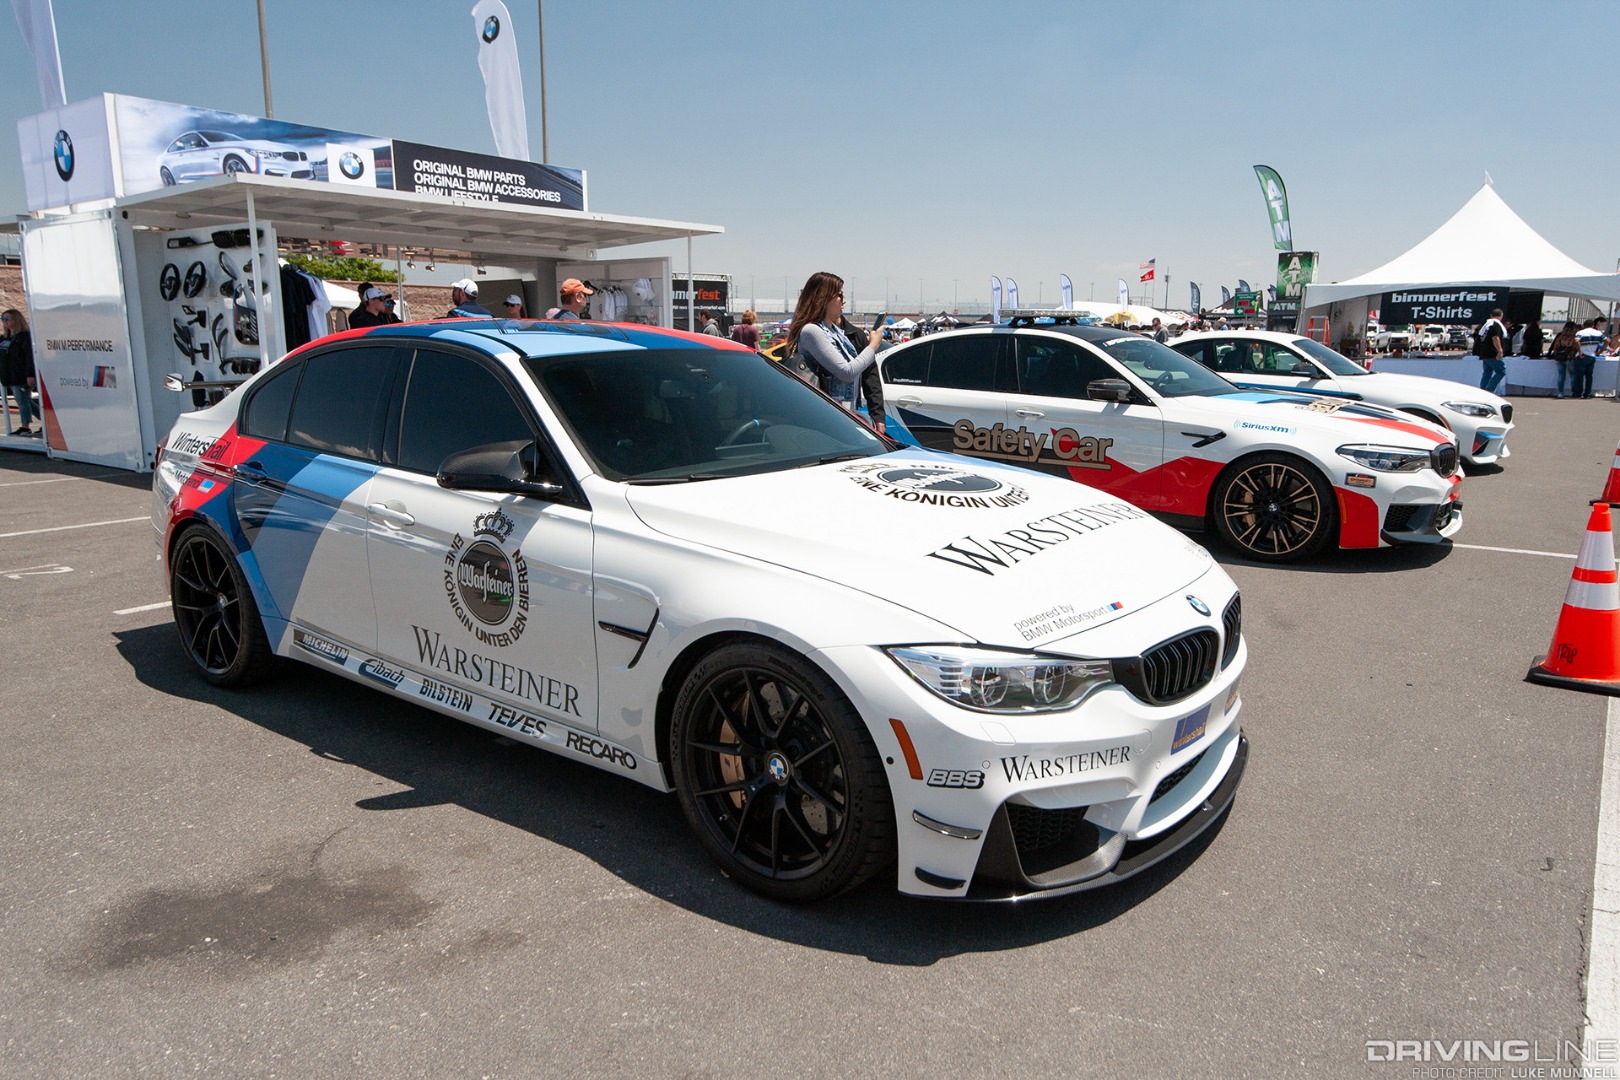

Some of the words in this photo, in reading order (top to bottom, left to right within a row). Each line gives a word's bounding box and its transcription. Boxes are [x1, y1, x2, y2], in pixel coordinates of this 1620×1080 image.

[413, 159, 466, 177] ORIGINAL
[466, 167, 493, 181] BMW
[493, 171, 526, 186] PARTS
[414, 173, 467, 189] ORIGINAL
[467, 180, 494, 194] BMW
[494, 185, 561, 203] ACCESSORIES
[1266, 179, 1292, 243] ATM
[1285, 256, 1302, 297] ATM
[1273, 302, 1296, 311] ATM
[1391, 291, 1497, 303] bimmerfest
[1411, 306, 1473, 319] T-Shirts
[67, 340, 114, 352] PERFORMANCE
[60, 377, 82, 387] powered
[82, 377, 89, 389] by
[171, 431, 232, 460] Wintershall
[952, 418, 1047, 463] Safety
[1051, 427, 1114, 462] Car
[850, 476, 888, 493] EINE
[885, 487, 992, 509] KÖNIGIN
[444, 532, 465, 568] EINE
[925, 502, 1153, 577] WARSTEINER
[511, 548, 530, 612] BIEREN
[443, 568, 474, 633] KÖNIGIN
[1013, 605, 1060, 632] powered
[1060, 601, 1076, 615] by
[475, 626, 513, 647] UNTER
[509, 611, 528, 641] DEN
[1021, 620, 1054, 642] BMW
[1053, 605, 1108, 631] Motorsport
[302, 634, 350, 659] MICHELIN
[358, 658, 406, 690] Eibach
[411, 624, 583, 717] WARSTEINER
[419, 678, 473, 712] BILSTEIN
[487, 702, 547, 738] TEVES
[565, 730, 638, 770] RECARO
[1000, 745, 1131, 783] WARSTEINER
[927, 768, 985, 789] BBS
